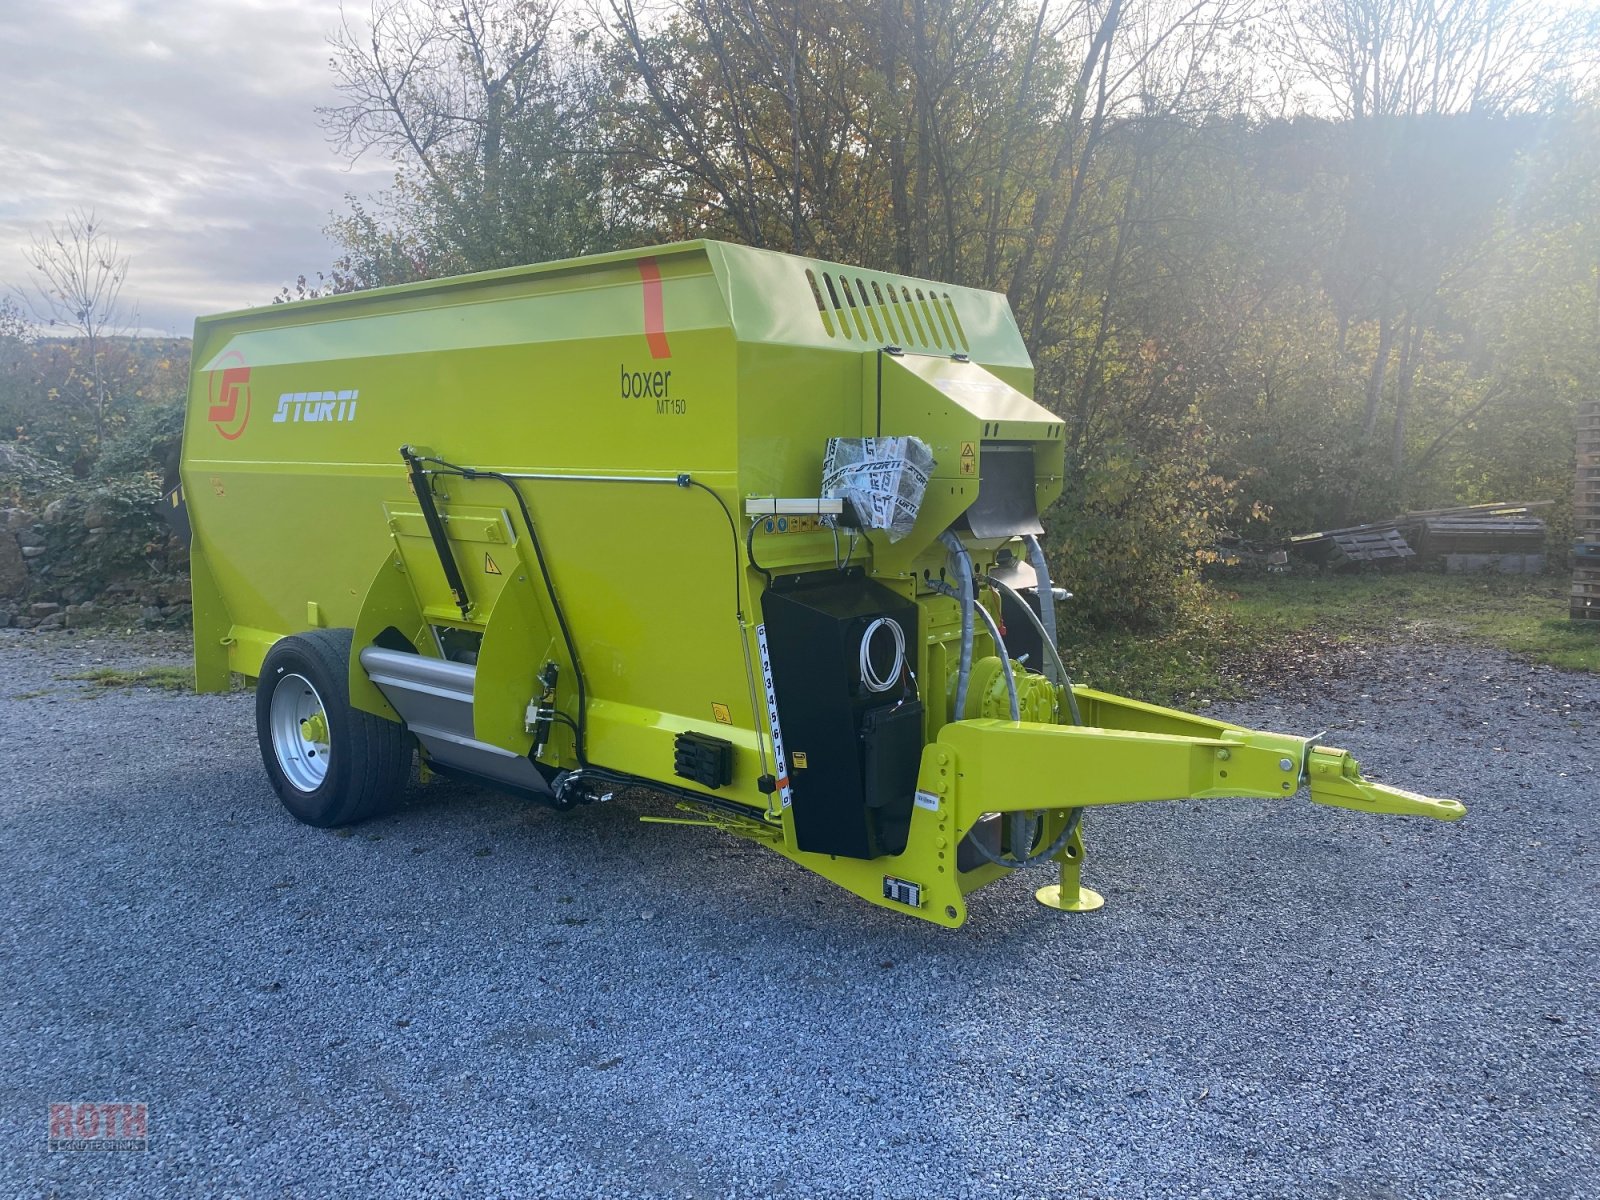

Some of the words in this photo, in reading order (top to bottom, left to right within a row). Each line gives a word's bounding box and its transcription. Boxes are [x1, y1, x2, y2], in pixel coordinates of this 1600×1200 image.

[621, 363, 671, 399] boxer
[272, 389, 359, 423] STORTI
[656, 399, 686, 415] MT150
[855, 460, 902, 473] STORTI
[761, 643, 767, 654] 1
[763, 661, 769, 672] 2
[766, 678, 772, 689] 3
[769, 695, 774, 705] 4
[771, 712, 777, 723] 5
[773, 728, 779, 740] 6
